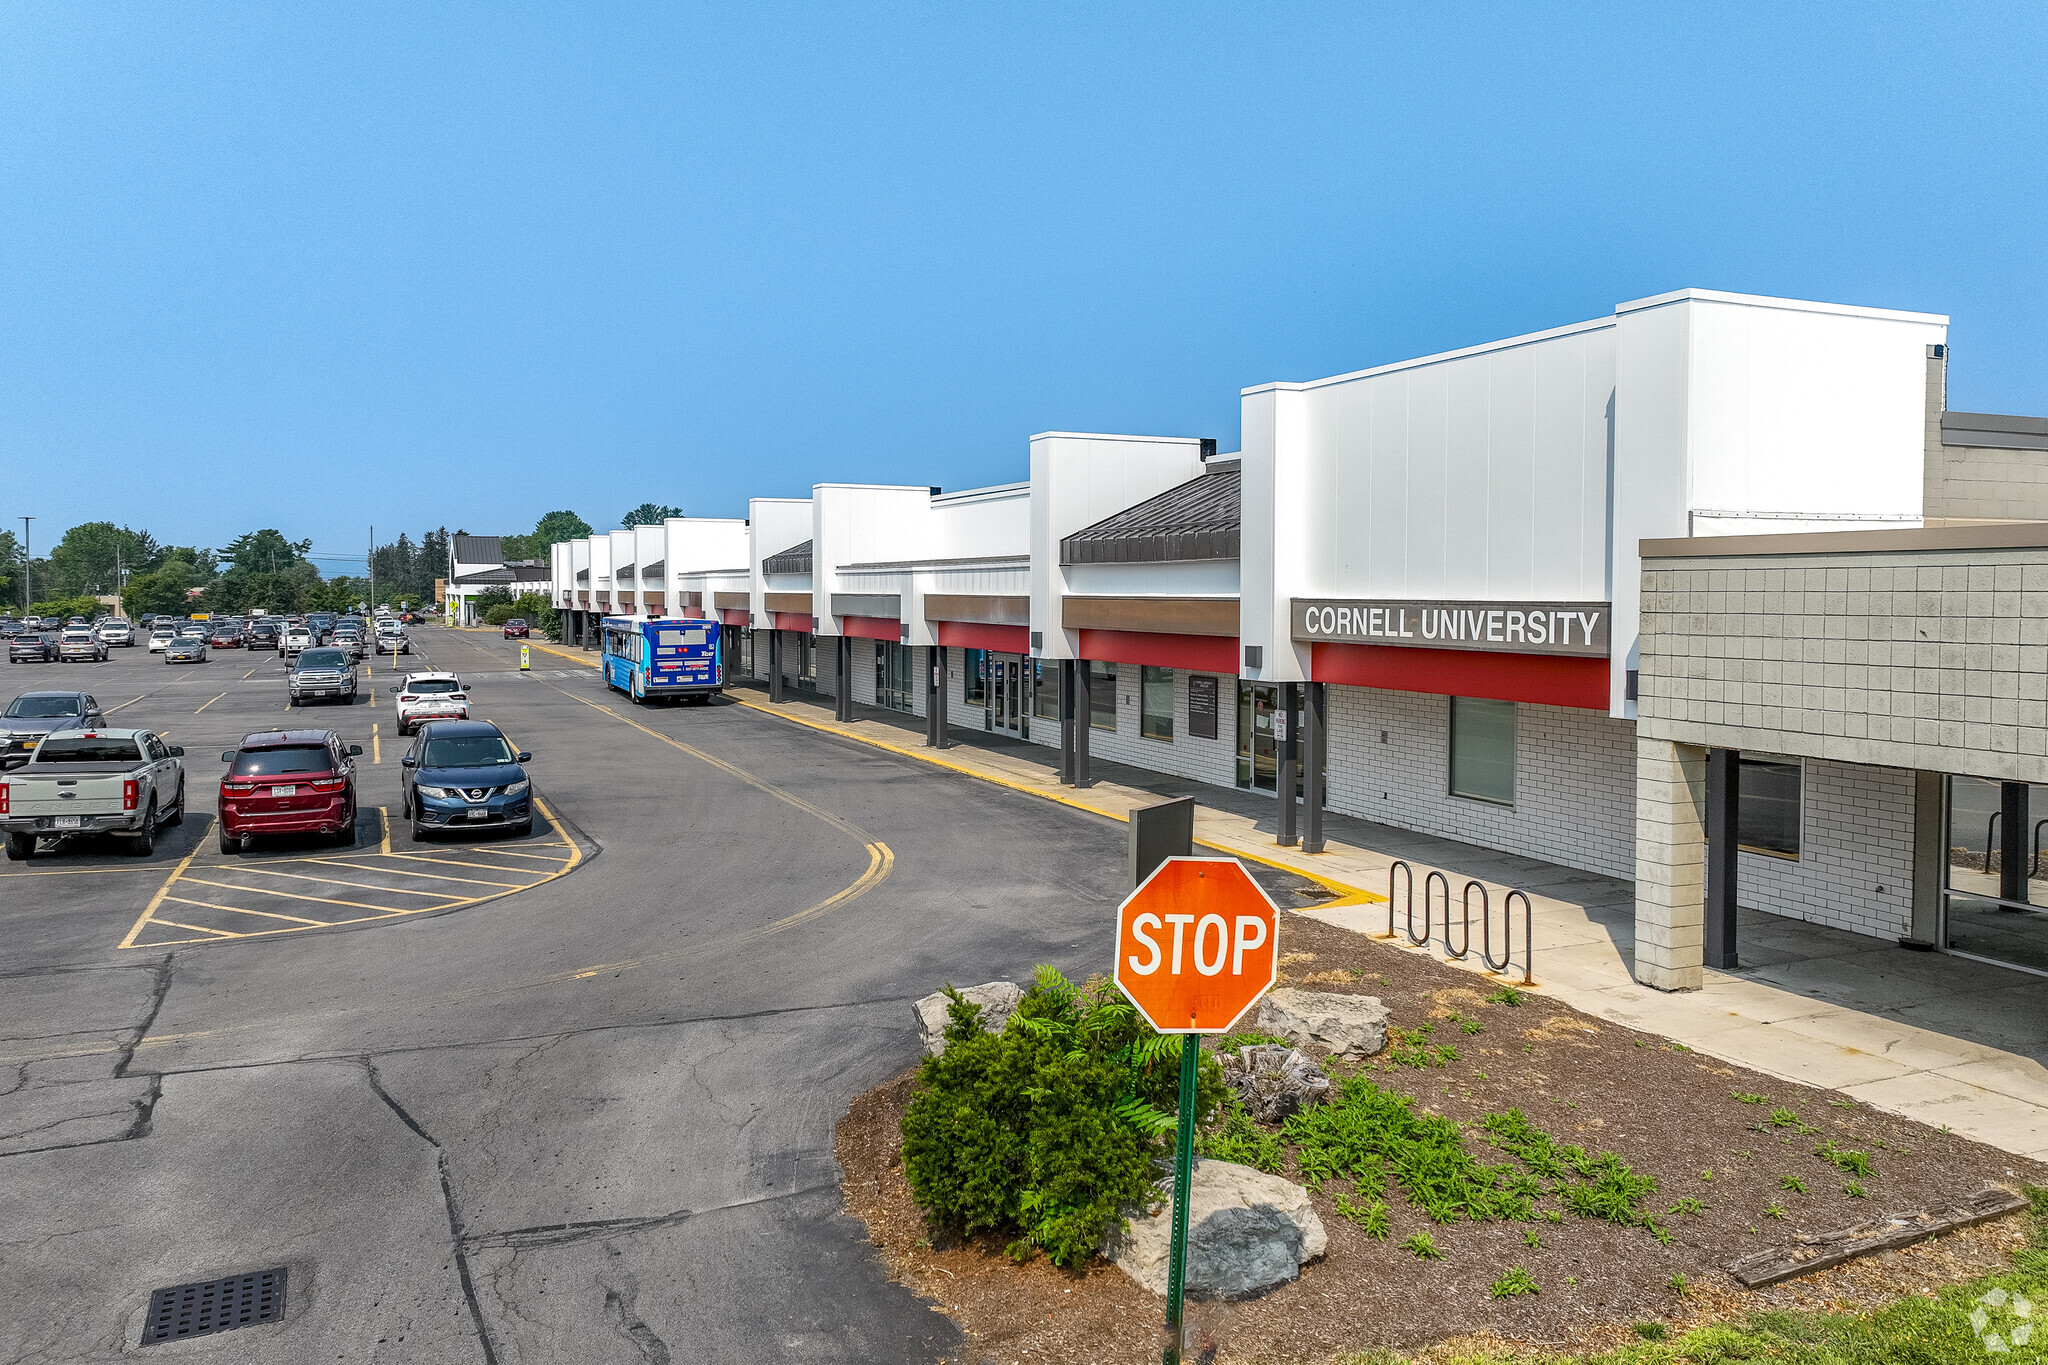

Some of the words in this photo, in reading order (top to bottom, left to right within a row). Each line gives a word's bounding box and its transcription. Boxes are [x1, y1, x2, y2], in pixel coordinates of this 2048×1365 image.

[1305, 606, 1413, 638] CORNELL
[1421, 609, 1600, 646] UNIVERSITY
[1128, 912, 1268, 977] STOP
